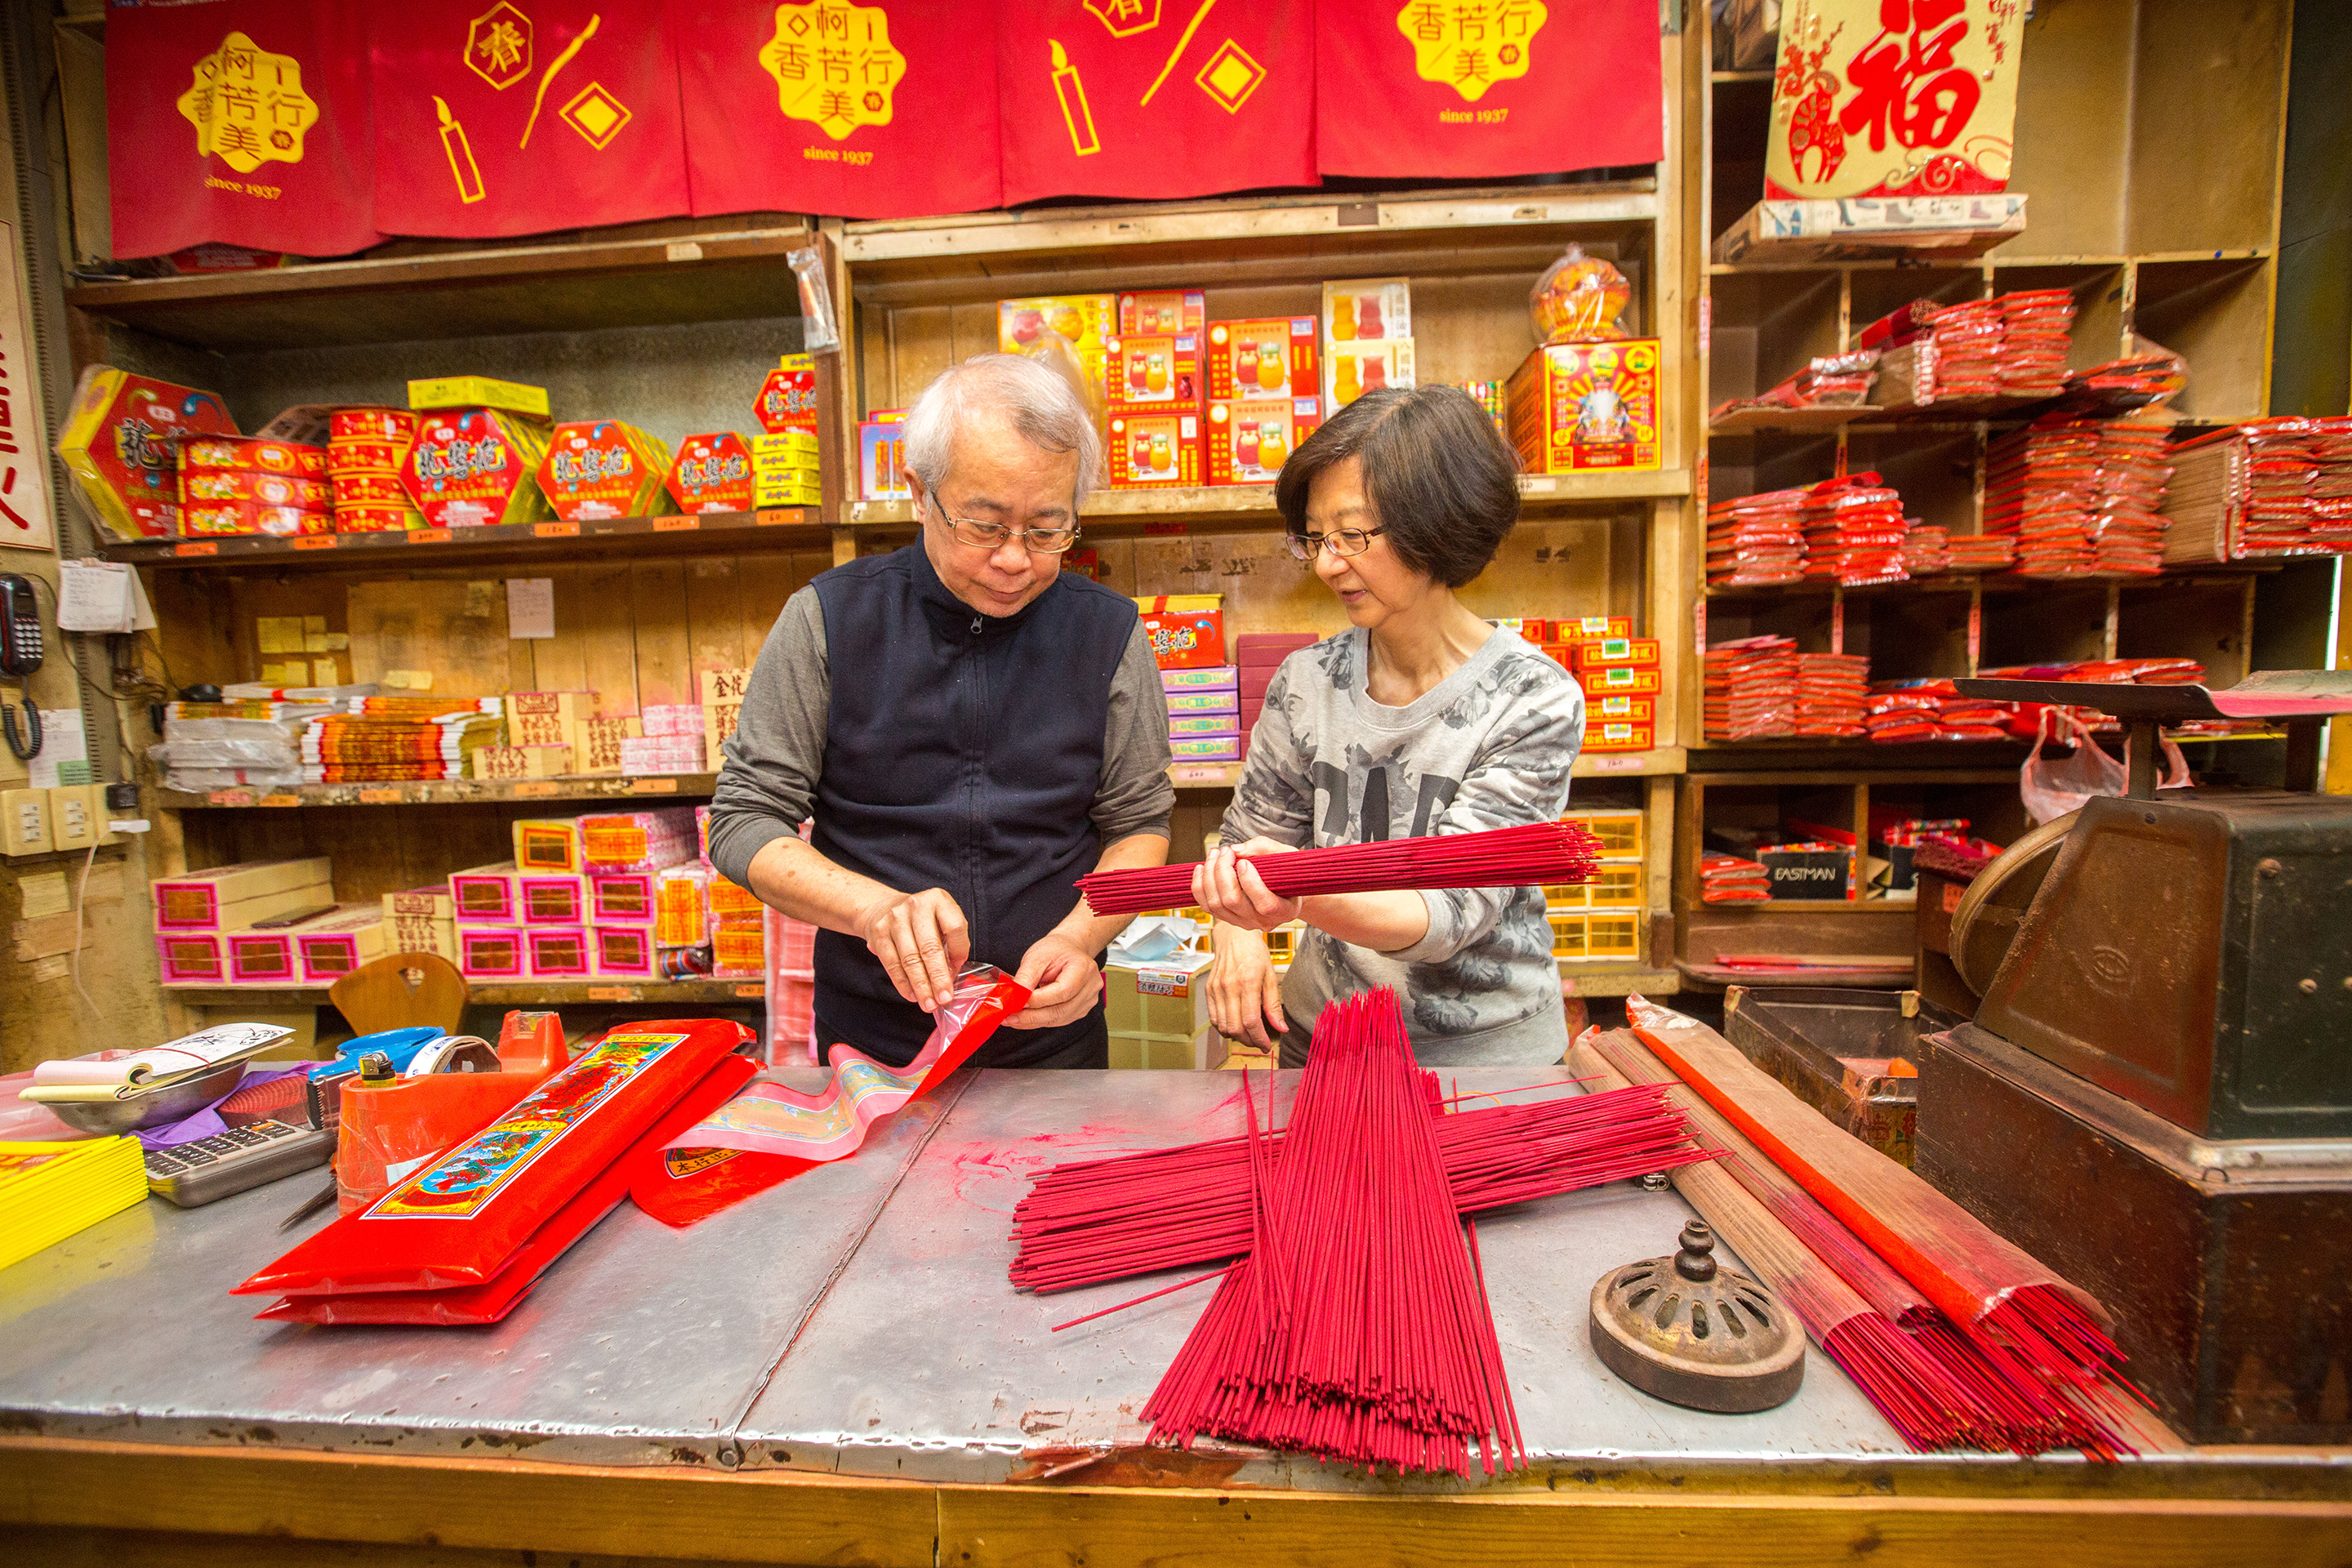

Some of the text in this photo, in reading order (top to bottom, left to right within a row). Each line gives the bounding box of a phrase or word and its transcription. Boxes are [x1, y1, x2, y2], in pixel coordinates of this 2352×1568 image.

[477, 20, 526, 74] 春
[1839, 0, 1981, 153] 福
[1439, 107, 1508, 123] since 1937
[803, 145, 874, 166] since 1937
[204, 173, 282, 200] since 1937
[1775, 867, 1836, 882] EASTMAN
